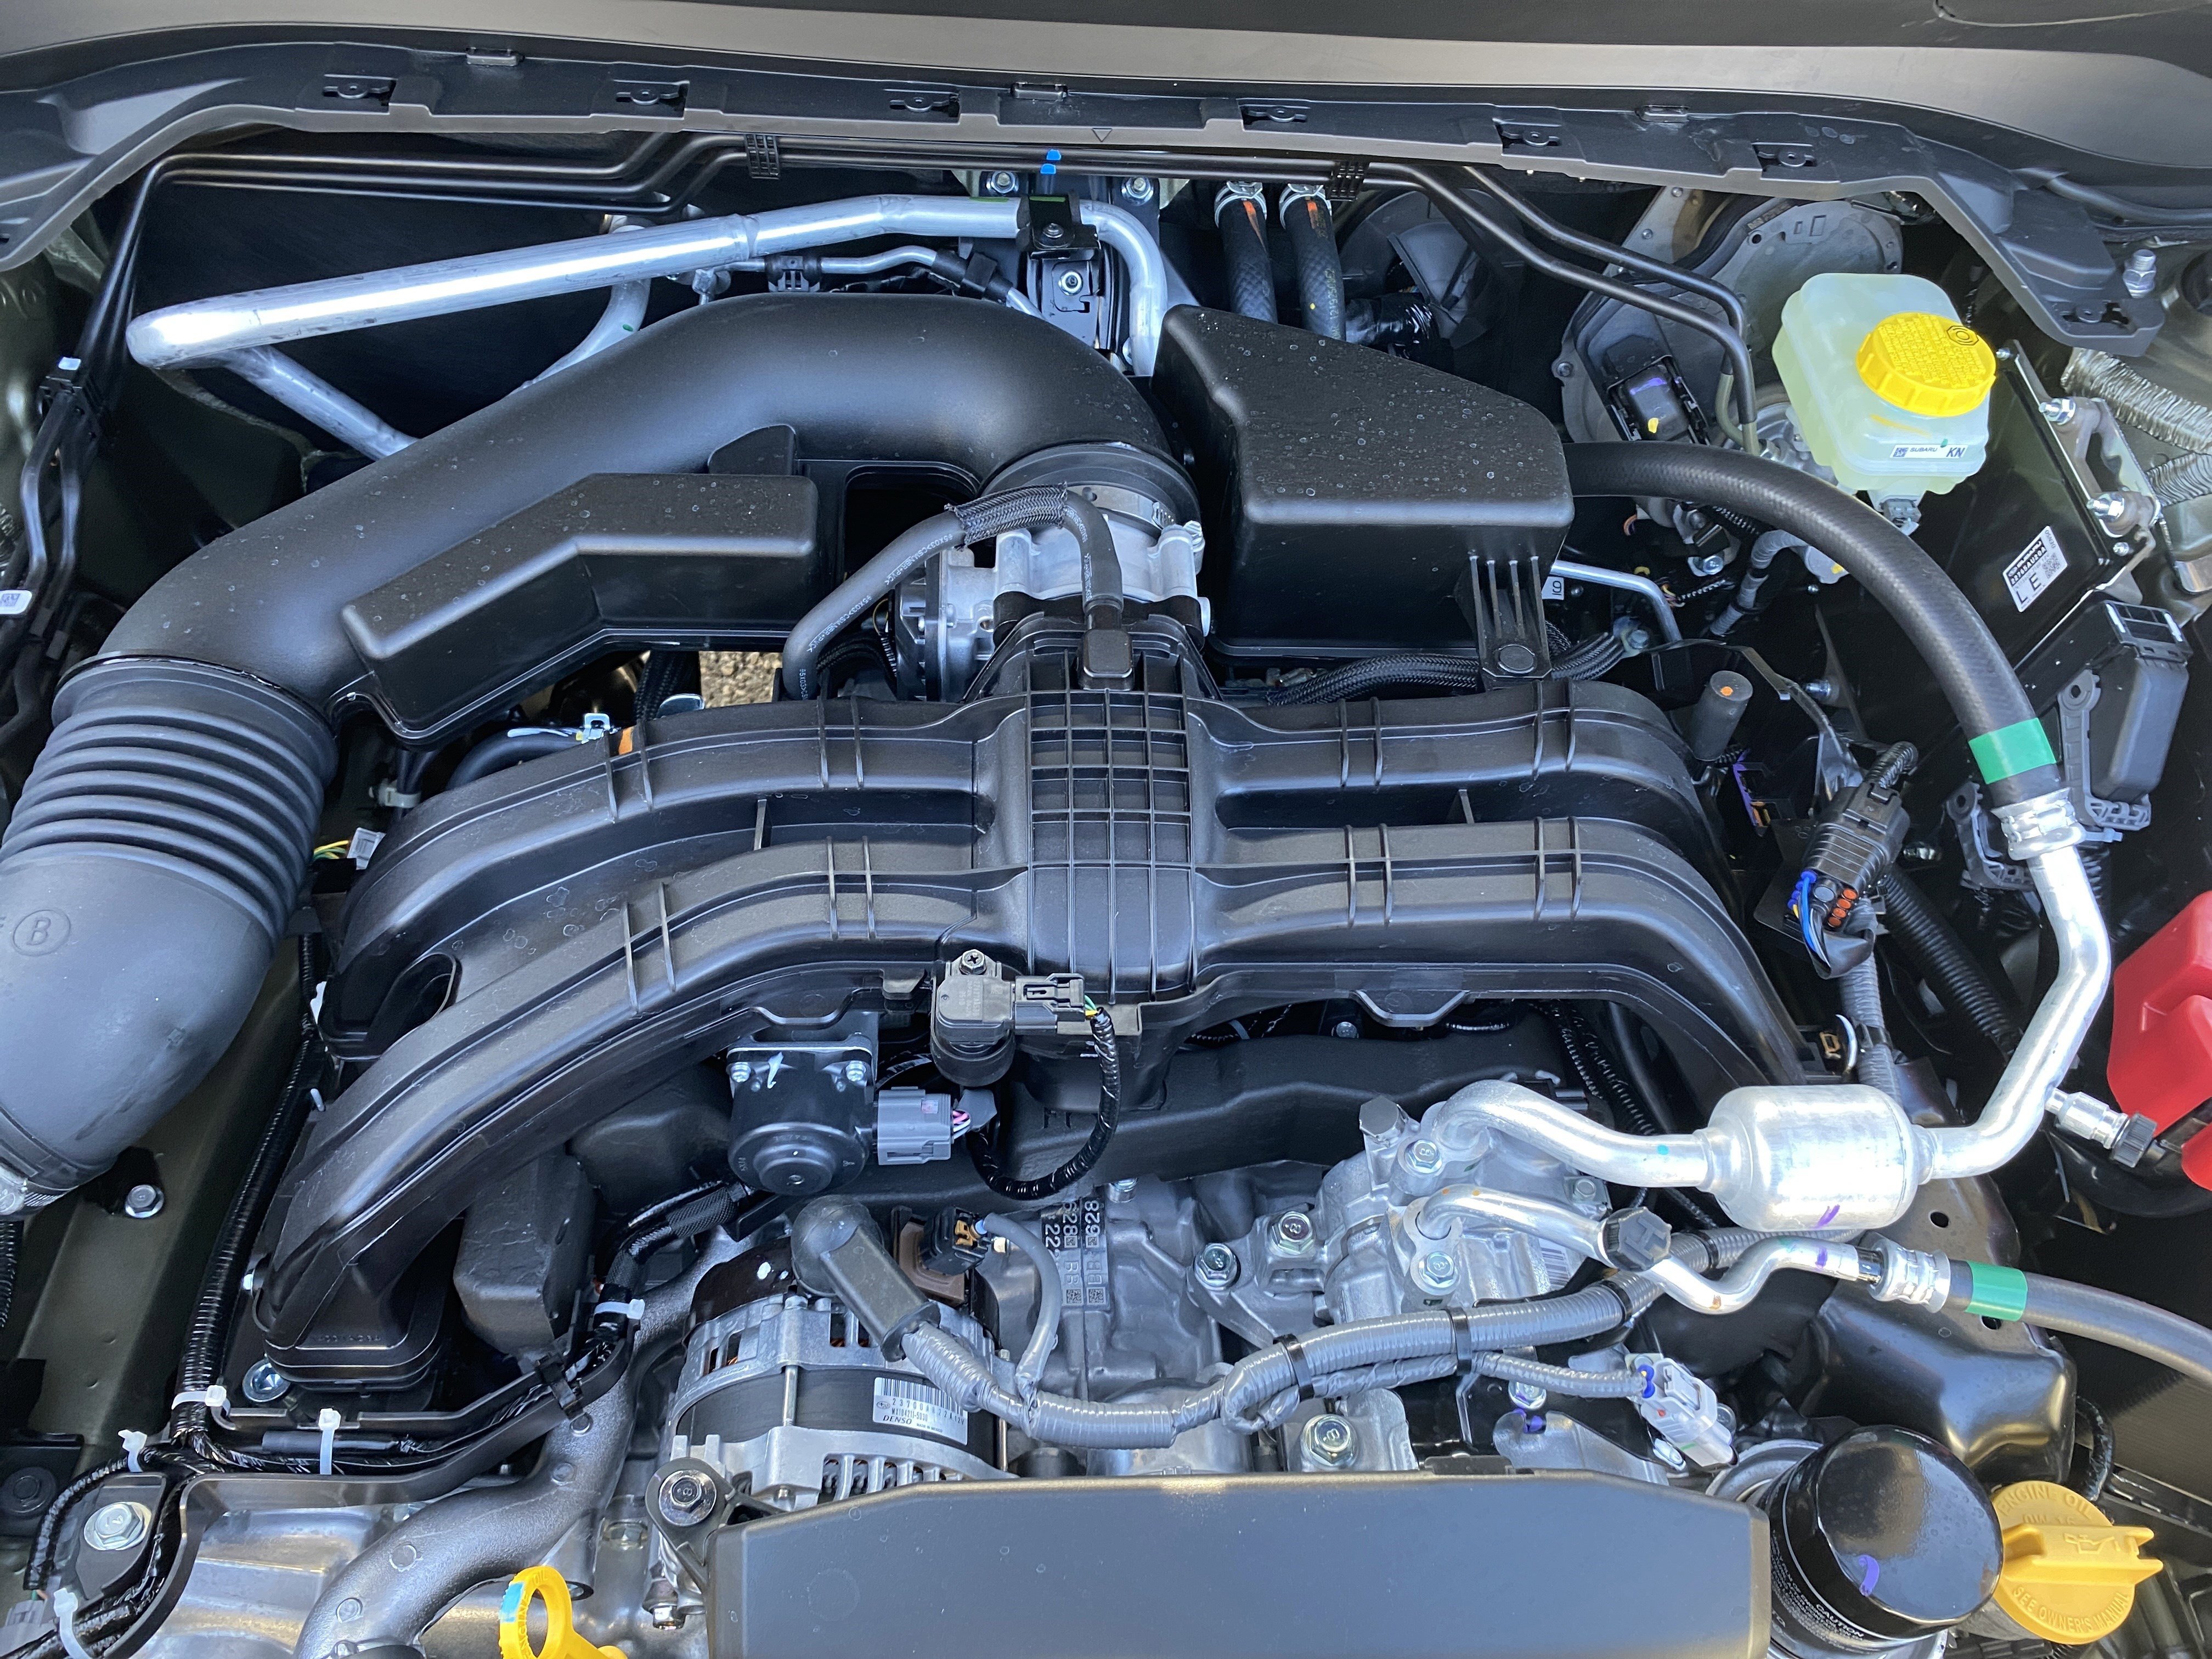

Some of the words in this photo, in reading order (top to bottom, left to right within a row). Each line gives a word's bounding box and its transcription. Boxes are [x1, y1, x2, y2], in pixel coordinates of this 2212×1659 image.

[1946, 447, 1966, 458] KN
[2029, 572, 2042, 592] E
[883, 1415, 912, 1425] DENSO
[1995, 1483, 2053, 1516] ENGINE
[2064, 1493, 2093, 1520] OIL
[532, 1569, 548, 1586] OIL
[2013, 1586, 2037, 1612] SEE
[2039, 1607, 2092, 1633] OWNER'S
[2092, 1592, 2130, 1630] MANUAL
[1816, 1604, 1864, 1638] CAUTION
